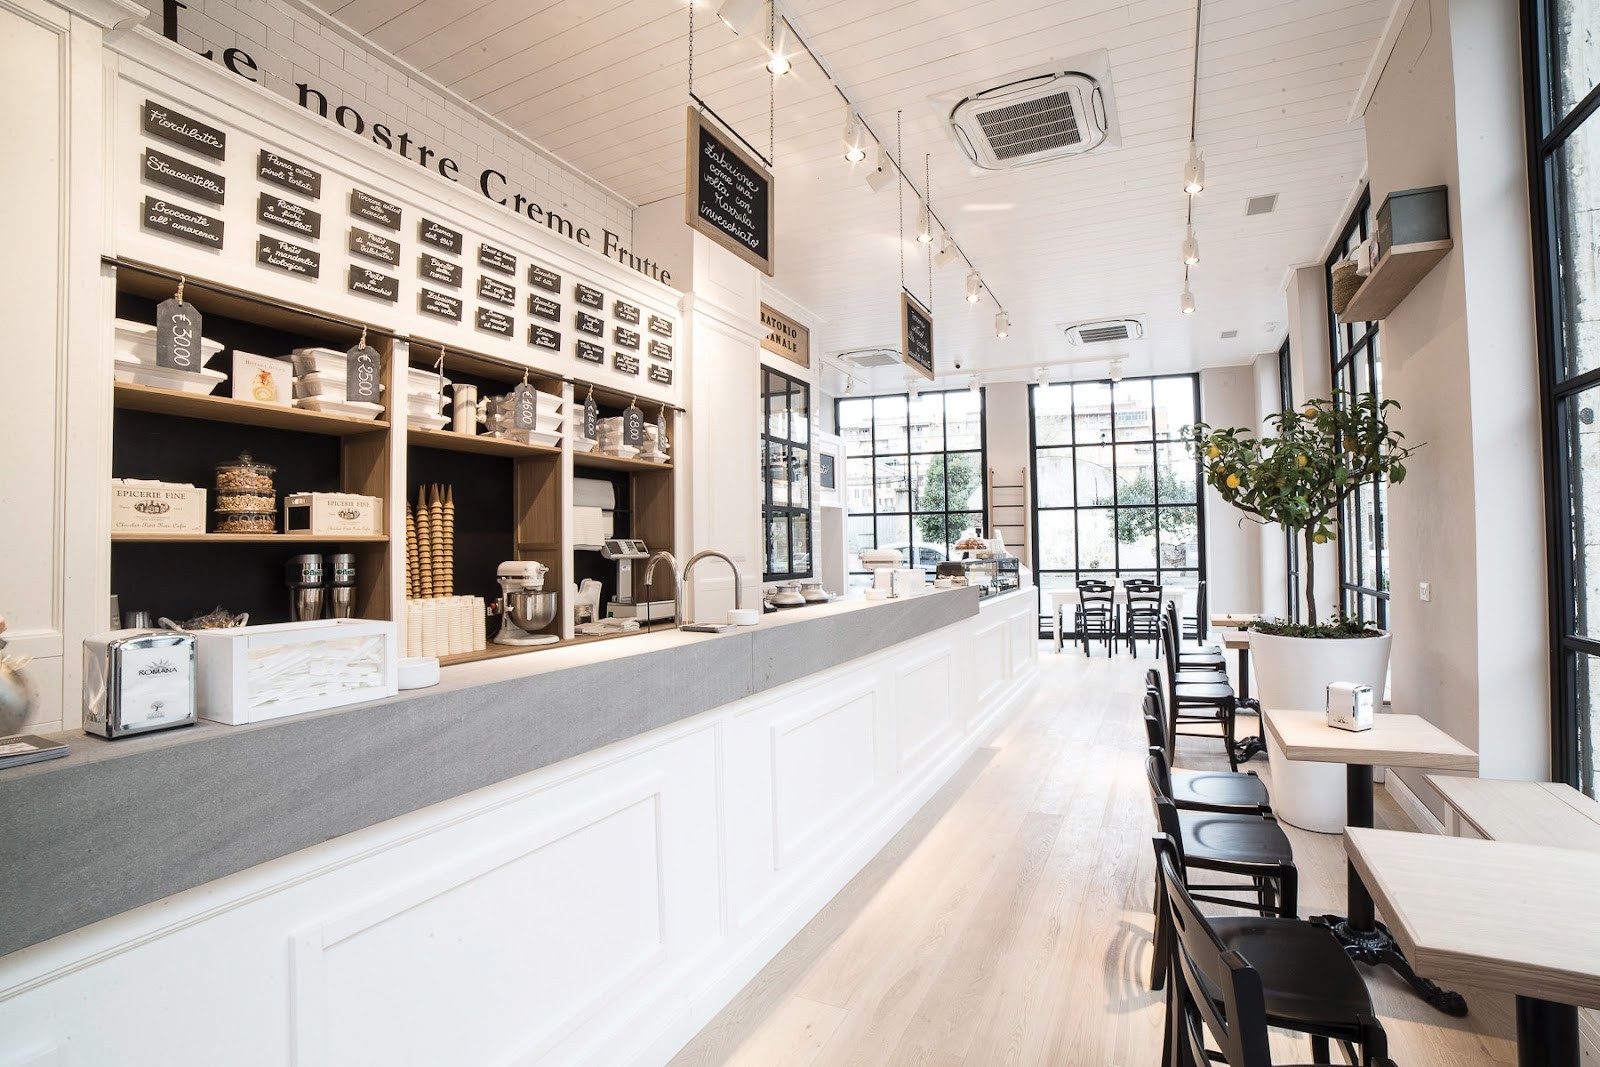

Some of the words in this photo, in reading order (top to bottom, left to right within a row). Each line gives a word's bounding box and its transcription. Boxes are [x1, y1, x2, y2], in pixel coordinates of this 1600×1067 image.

[150, 109, 223, 148] Fiordilatte
[162, 0, 258, 82] Le
[295, 82, 460, 182] nostre
[480, 169, 591, 248] Creme
[601, 227, 672, 287] Frutte
[146, 155, 224, 194] Stracciatella
[267, 153, 294, 171] Panna
[704, 141, 759, 192] Zabaione
[703, 172, 730, 198] volta
[735, 196, 753, 215] con
[709, 163, 733, 186] come
[735, 182, 753, 200] una
[151, 201, 210, 227] Croccante
[263, 212, 313, 233] caramellati
[277, 199, 306, 216] Ricotta
[171, 222, 220, 241] amarena
[700, 200, 760, 249] invecchiato
[117, 490, 161, 499] EPICERIE
[165, 492, 186, 500] FINE
[138, 667, 178, 676] ROMANA
